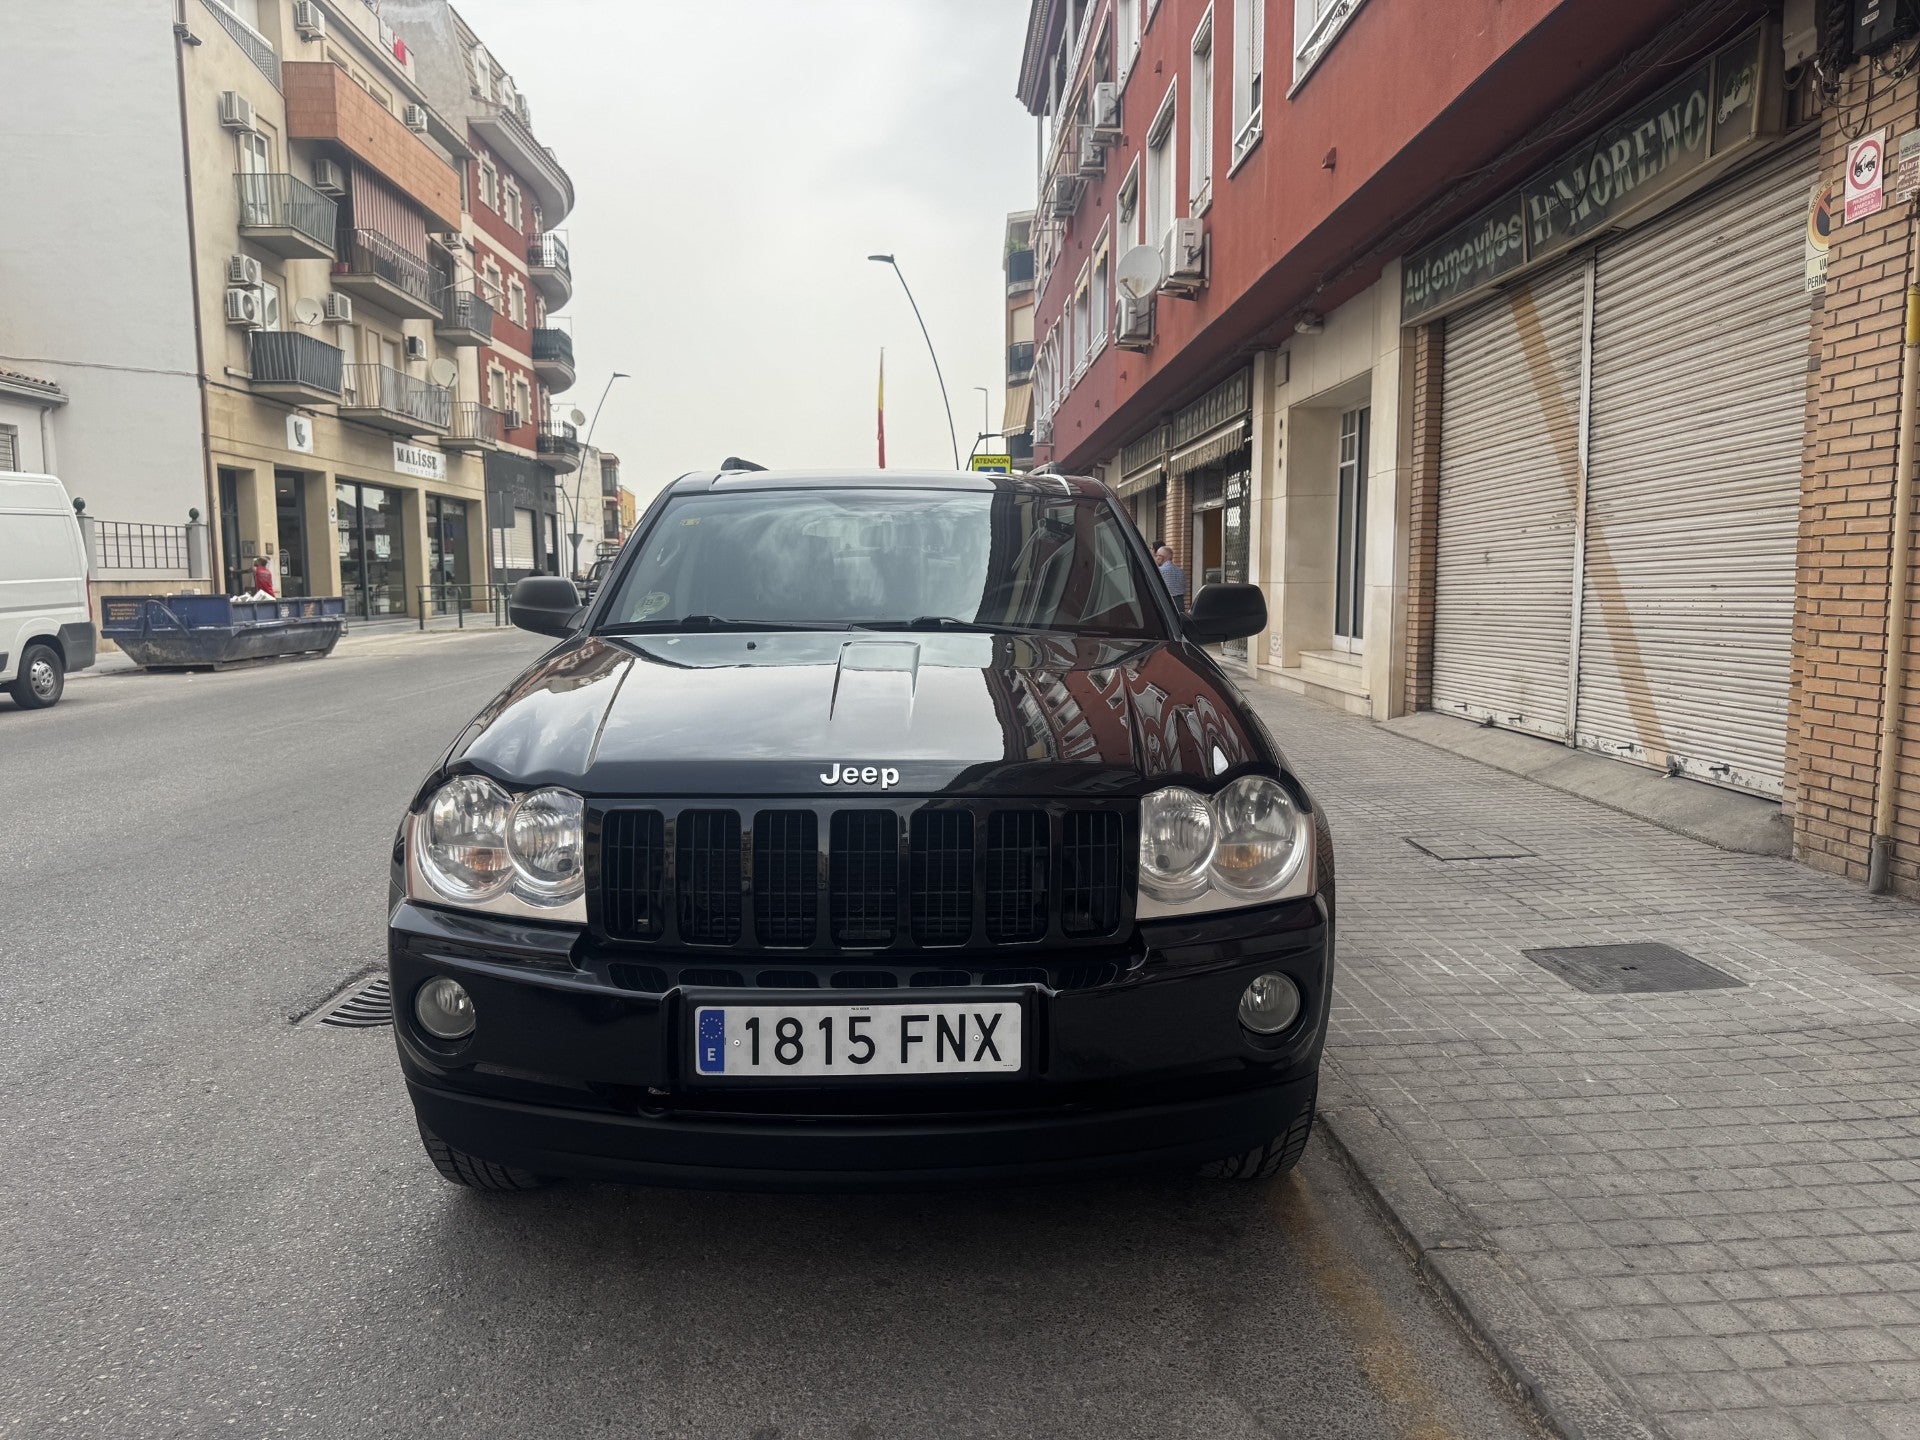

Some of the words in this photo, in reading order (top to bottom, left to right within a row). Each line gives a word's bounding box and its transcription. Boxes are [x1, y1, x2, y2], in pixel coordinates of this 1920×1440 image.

[1550, 89, 1706, 228] MORENO
[975, 456, 1009, 465] ATENCIÓN
[820, 763, 900, 790] Jeep
[706, 1048, 716, 1061] E
[745, 1016, 876, 1066] 1815
[900, 1013, 1003, 1064] FNX
